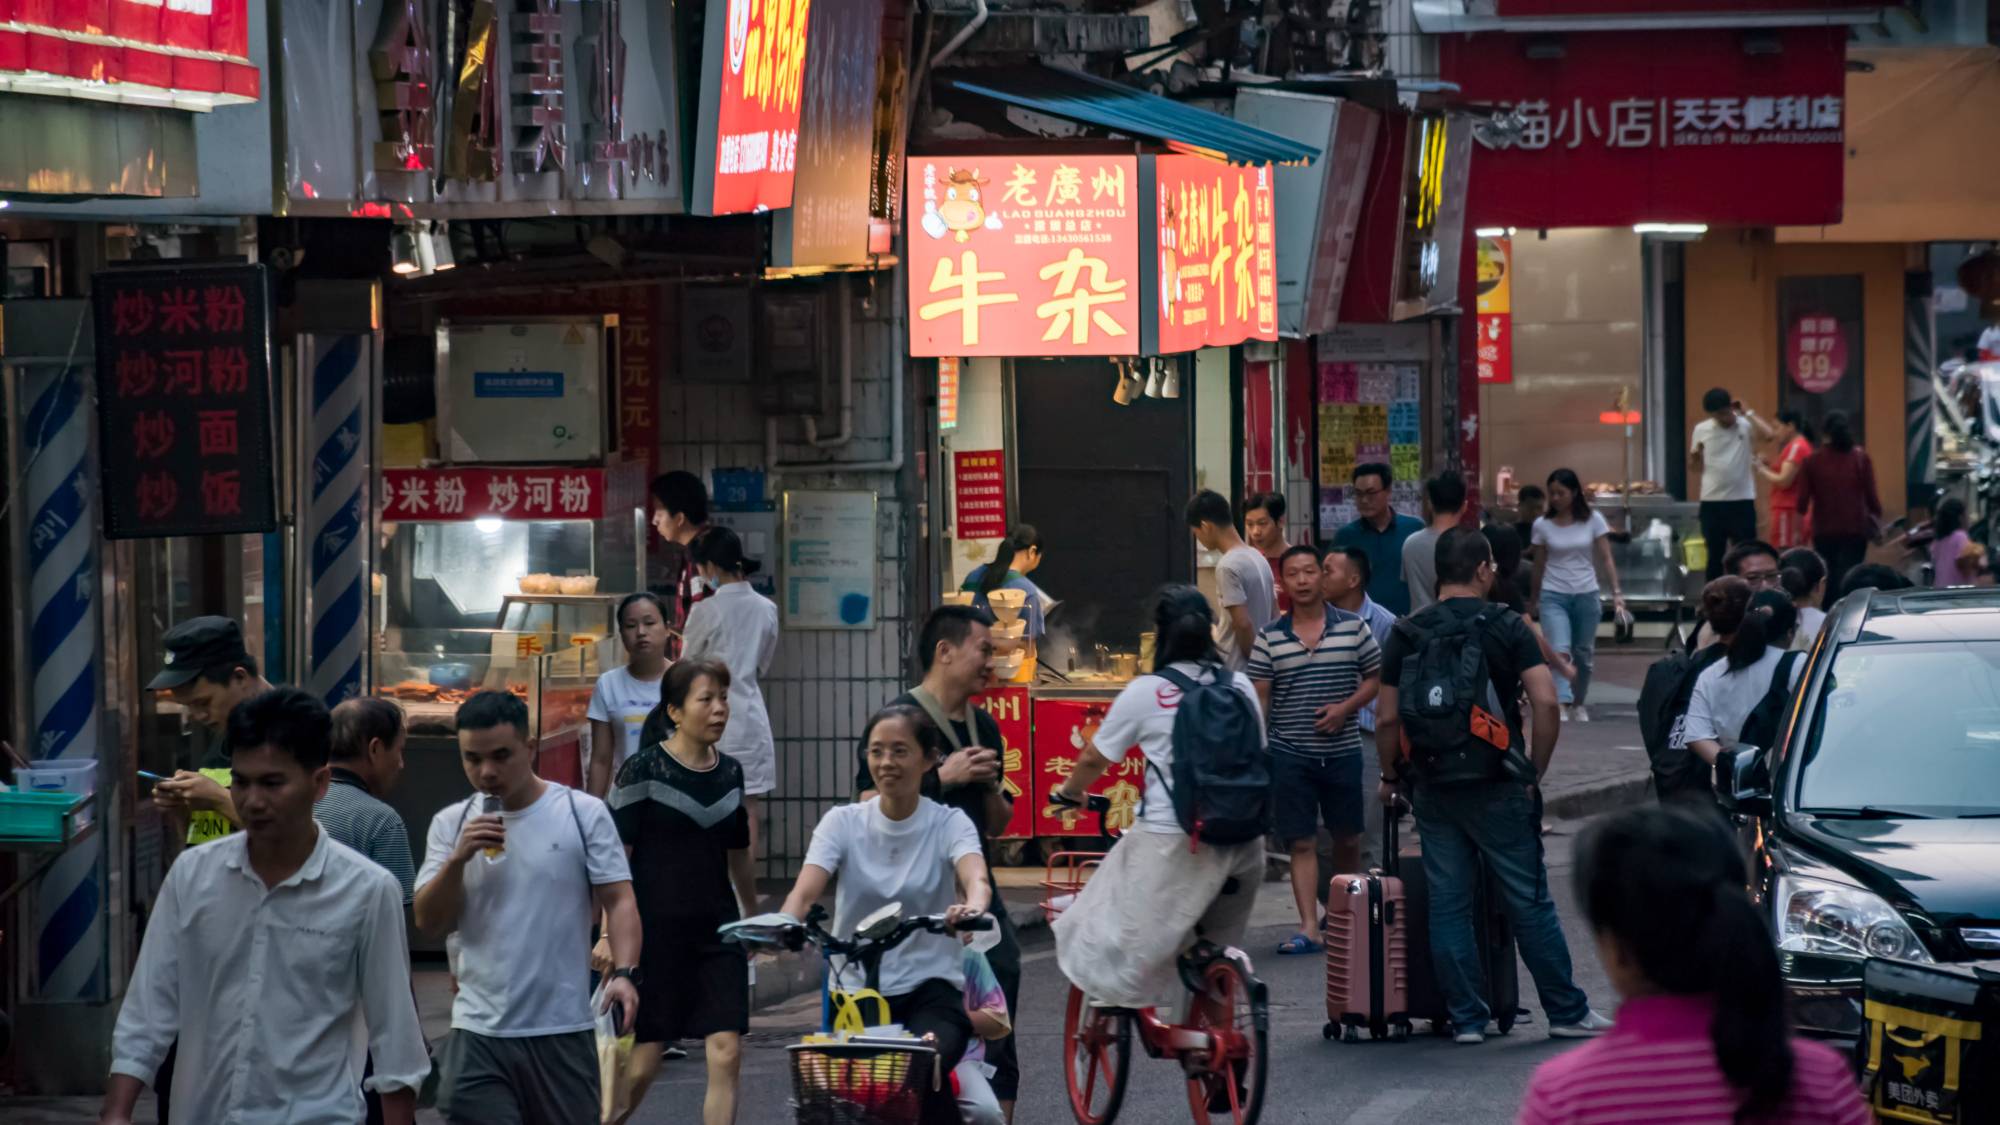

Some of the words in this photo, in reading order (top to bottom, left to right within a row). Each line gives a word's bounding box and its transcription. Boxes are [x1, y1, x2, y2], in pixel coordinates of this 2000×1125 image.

[1673, 96, 1842, 130] 天天便利店
[1002, 163, 1126, 207] 老廣州
[1003, 209, 1031, 218] LAO
[1211, 173, 1255, 327] 牛杂
[113, 285, 246, 336] 炒米粉
[919, 247, 1128, 346] 牛杂
[115, 345, 249, 398] 炒河粉
[488, 475, 591, 514] 炒河粉
[727, 486, 747, 503] 29
[1044, 756, 1147, 777] 老州
